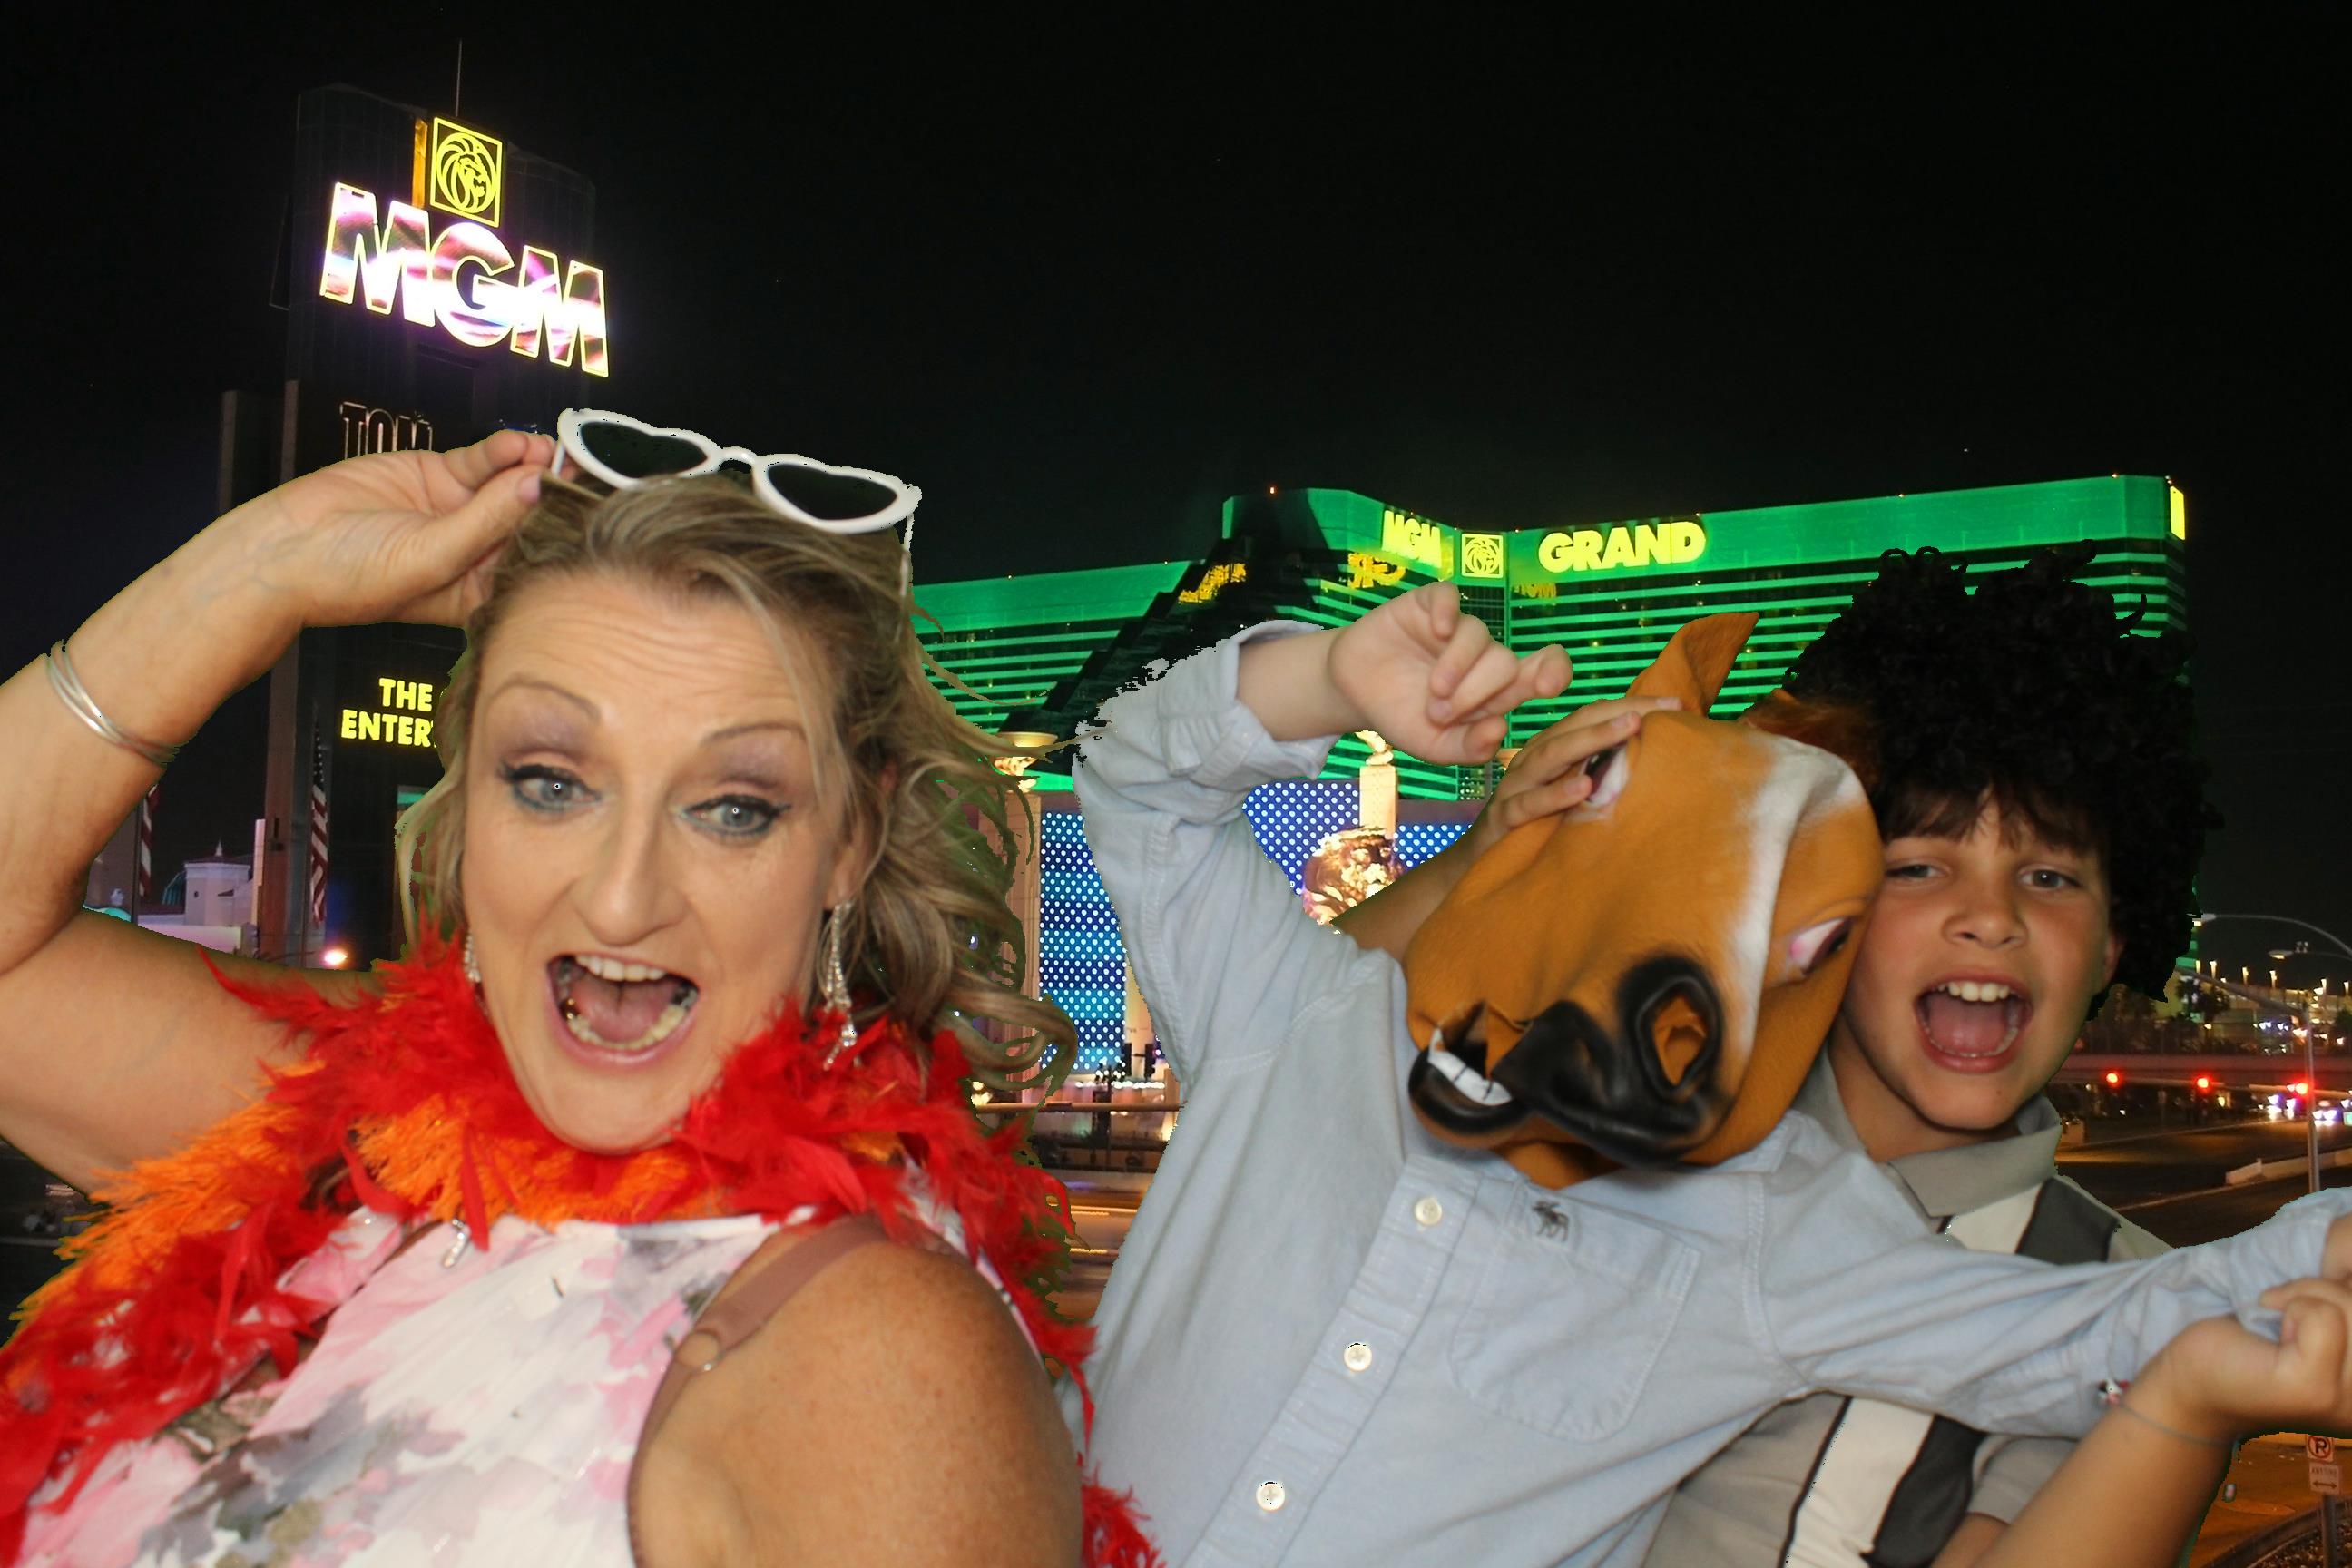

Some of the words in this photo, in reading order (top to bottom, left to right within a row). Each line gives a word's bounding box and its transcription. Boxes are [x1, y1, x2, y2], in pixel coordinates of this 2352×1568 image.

[320, 182, 609, 377] MGM
[1381, 510, 1442, 569] MGM
[1538, 521, 1706, 573] GRAND
[378, 678, 433, 711] THE
[340, 709, 436, 748] ENTER
